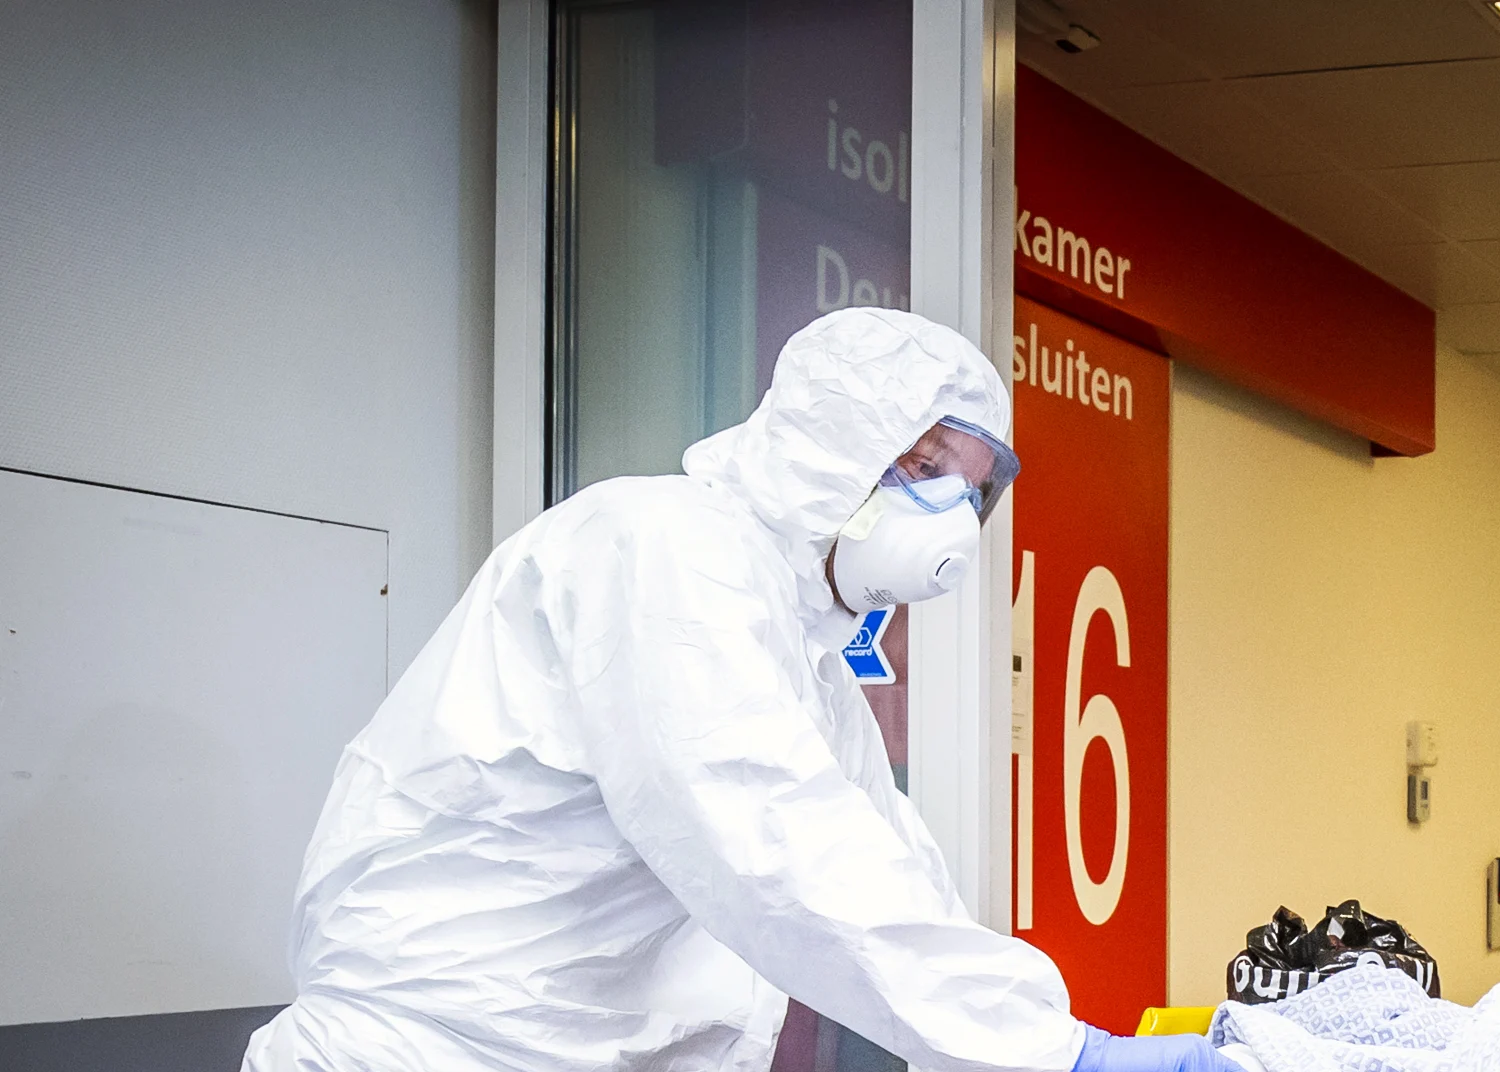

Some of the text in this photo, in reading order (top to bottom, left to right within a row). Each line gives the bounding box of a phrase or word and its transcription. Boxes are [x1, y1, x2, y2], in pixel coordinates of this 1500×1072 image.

[1012, 322, 1133, 421] sluiten
[844, 646, 873, 658] record
[1012, 550, 1131, 930] 16
